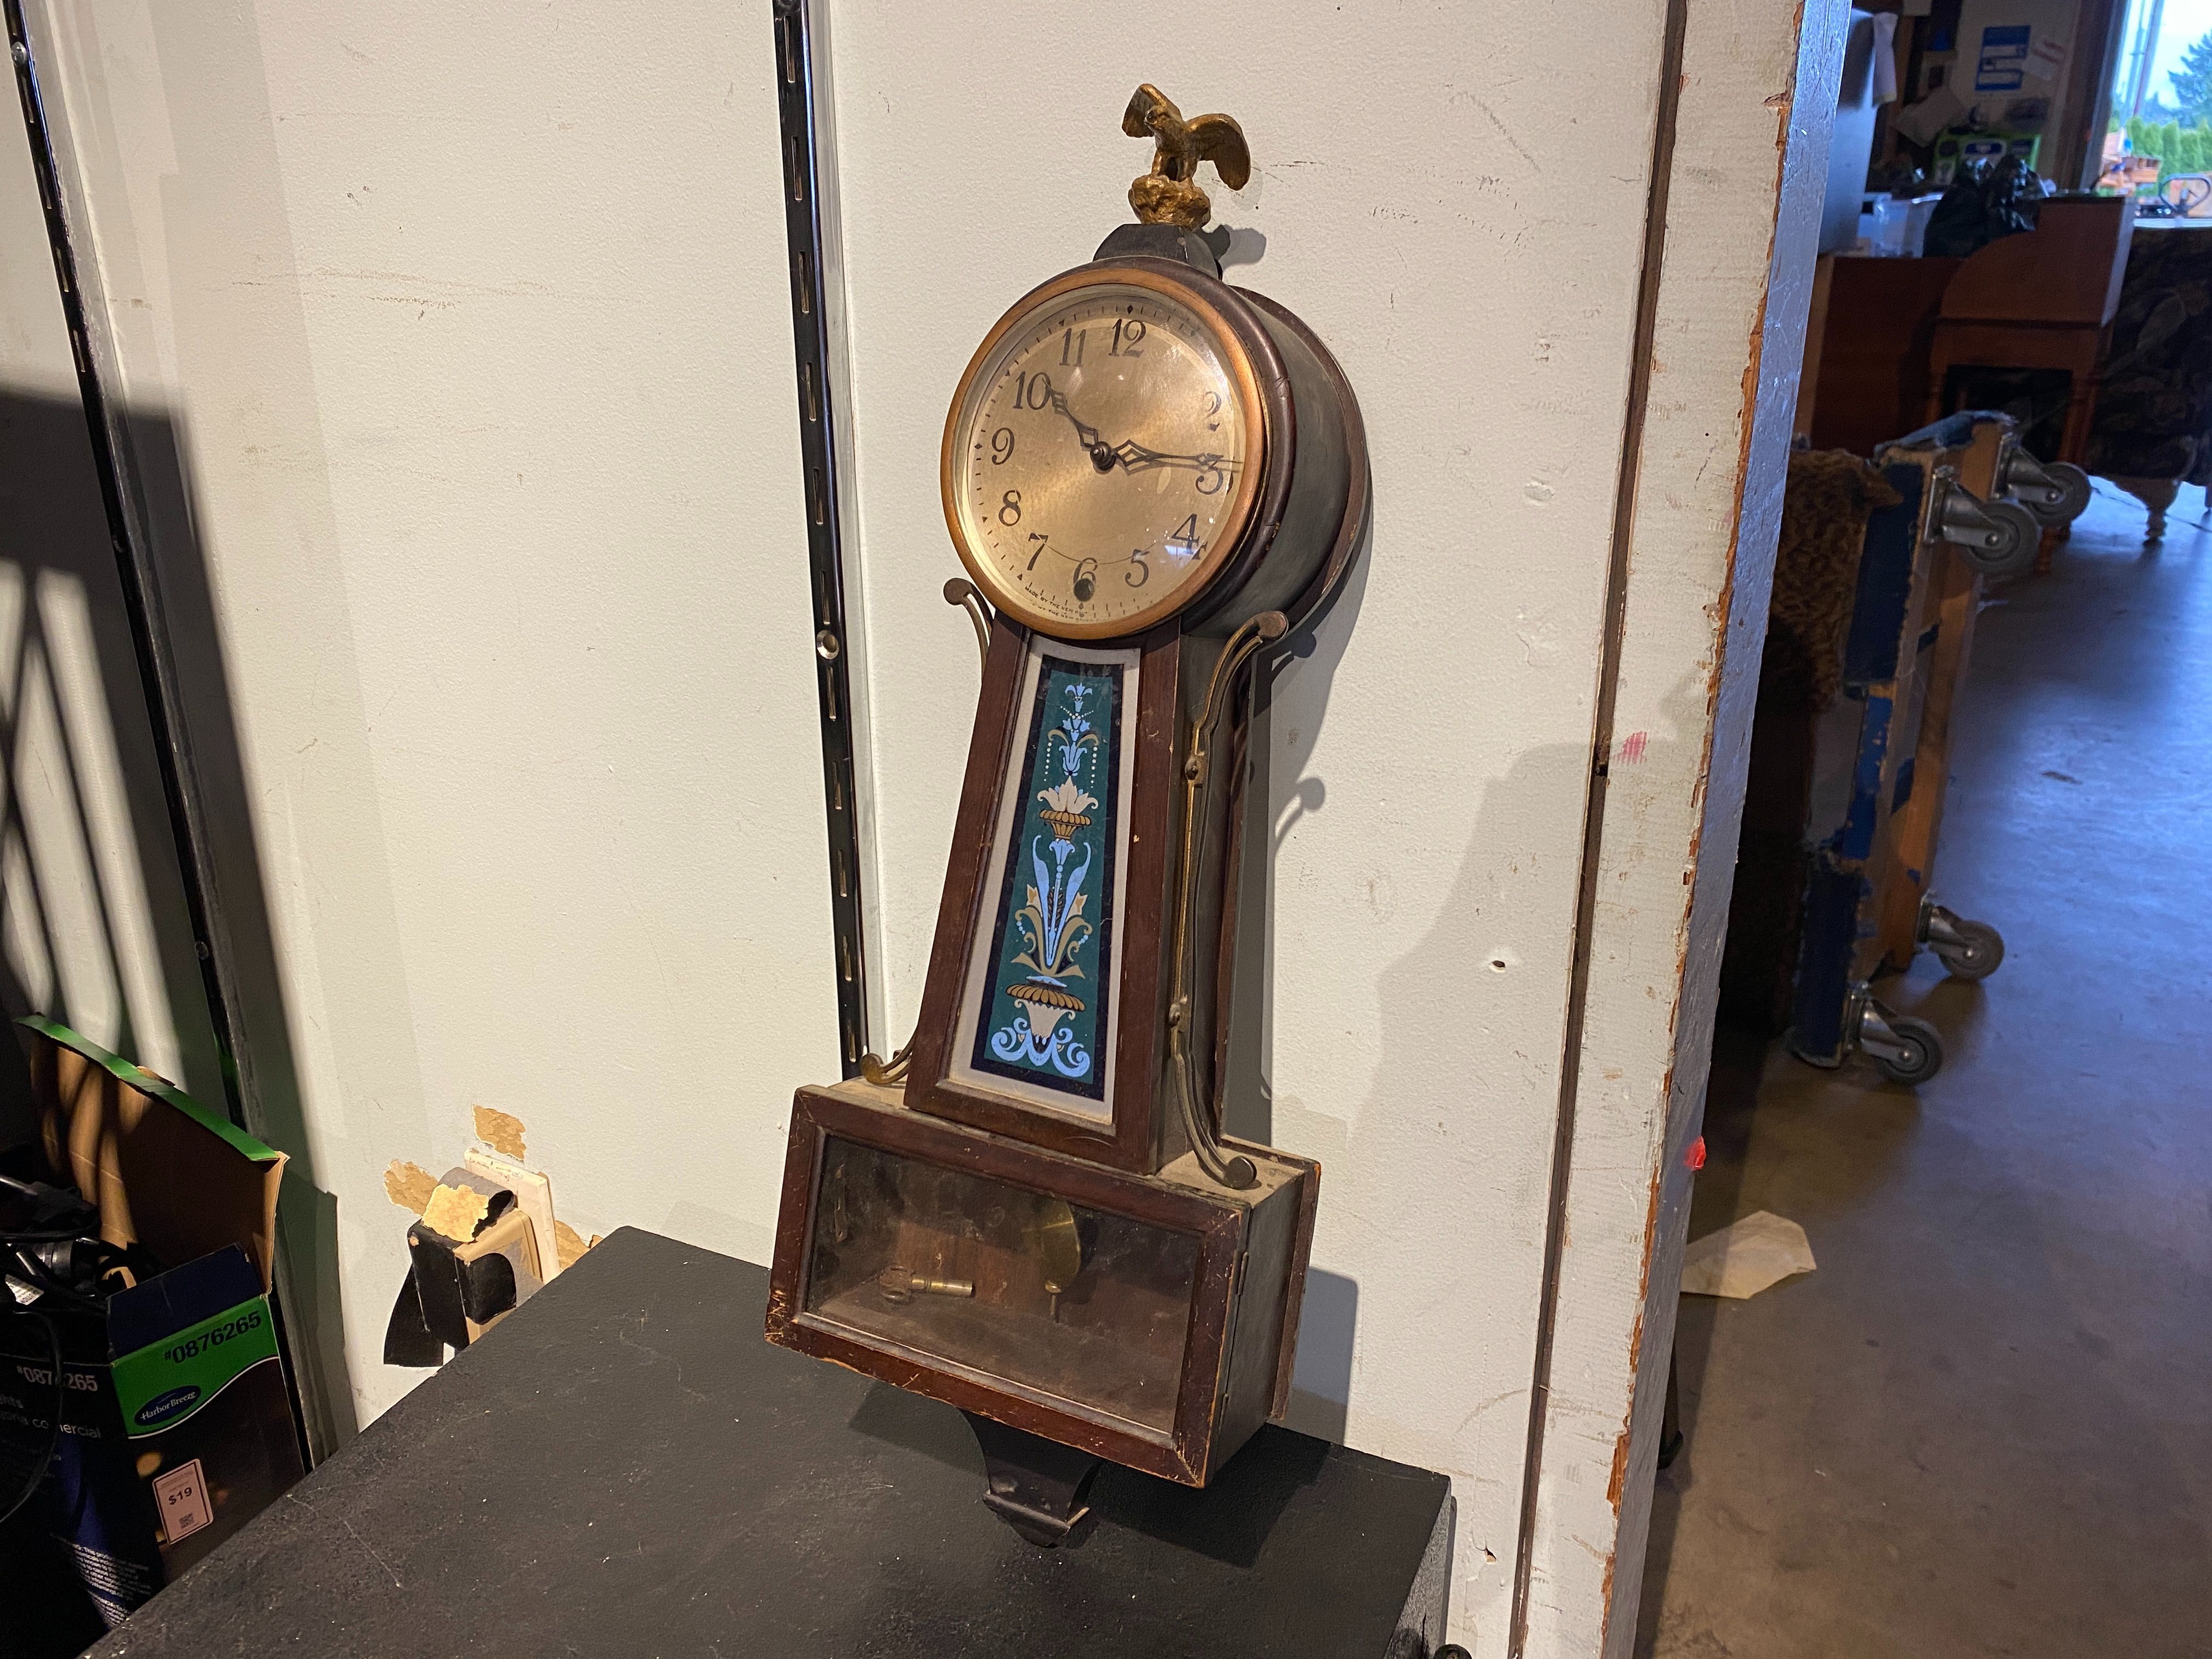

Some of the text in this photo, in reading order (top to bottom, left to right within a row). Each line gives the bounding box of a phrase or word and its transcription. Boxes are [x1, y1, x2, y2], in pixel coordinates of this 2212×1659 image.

[1059, 328, 1086, 367] 11
[1109, 318, 1146, 358] 12
[1012, 371, 1052, 410] 10
[1201, 391, 1222, 432] 2
[991, 427, 1015, 465] 9
[1195, 453, 1224, 495] 3
[997, 489, 1022, 527] 8
[1028, 533, 1048, 571] 7
[1171, 514, 1204, 557] 4
[1073, 557, 1097, 595] 6
[1125, 549, 1150, 588] 5
[1025, 586, 1039, 598] MADE
[165, 1310, 262, 1364] #0876265
[16, 1364, 99, 1392] #087265
[0, 1394, 24, 1409] hts
[140, 1390, 196, 1420] Harbor Breeze
[32, 1418, 101, 1438] coercial
[168, 1487, 193, 1505] $19
